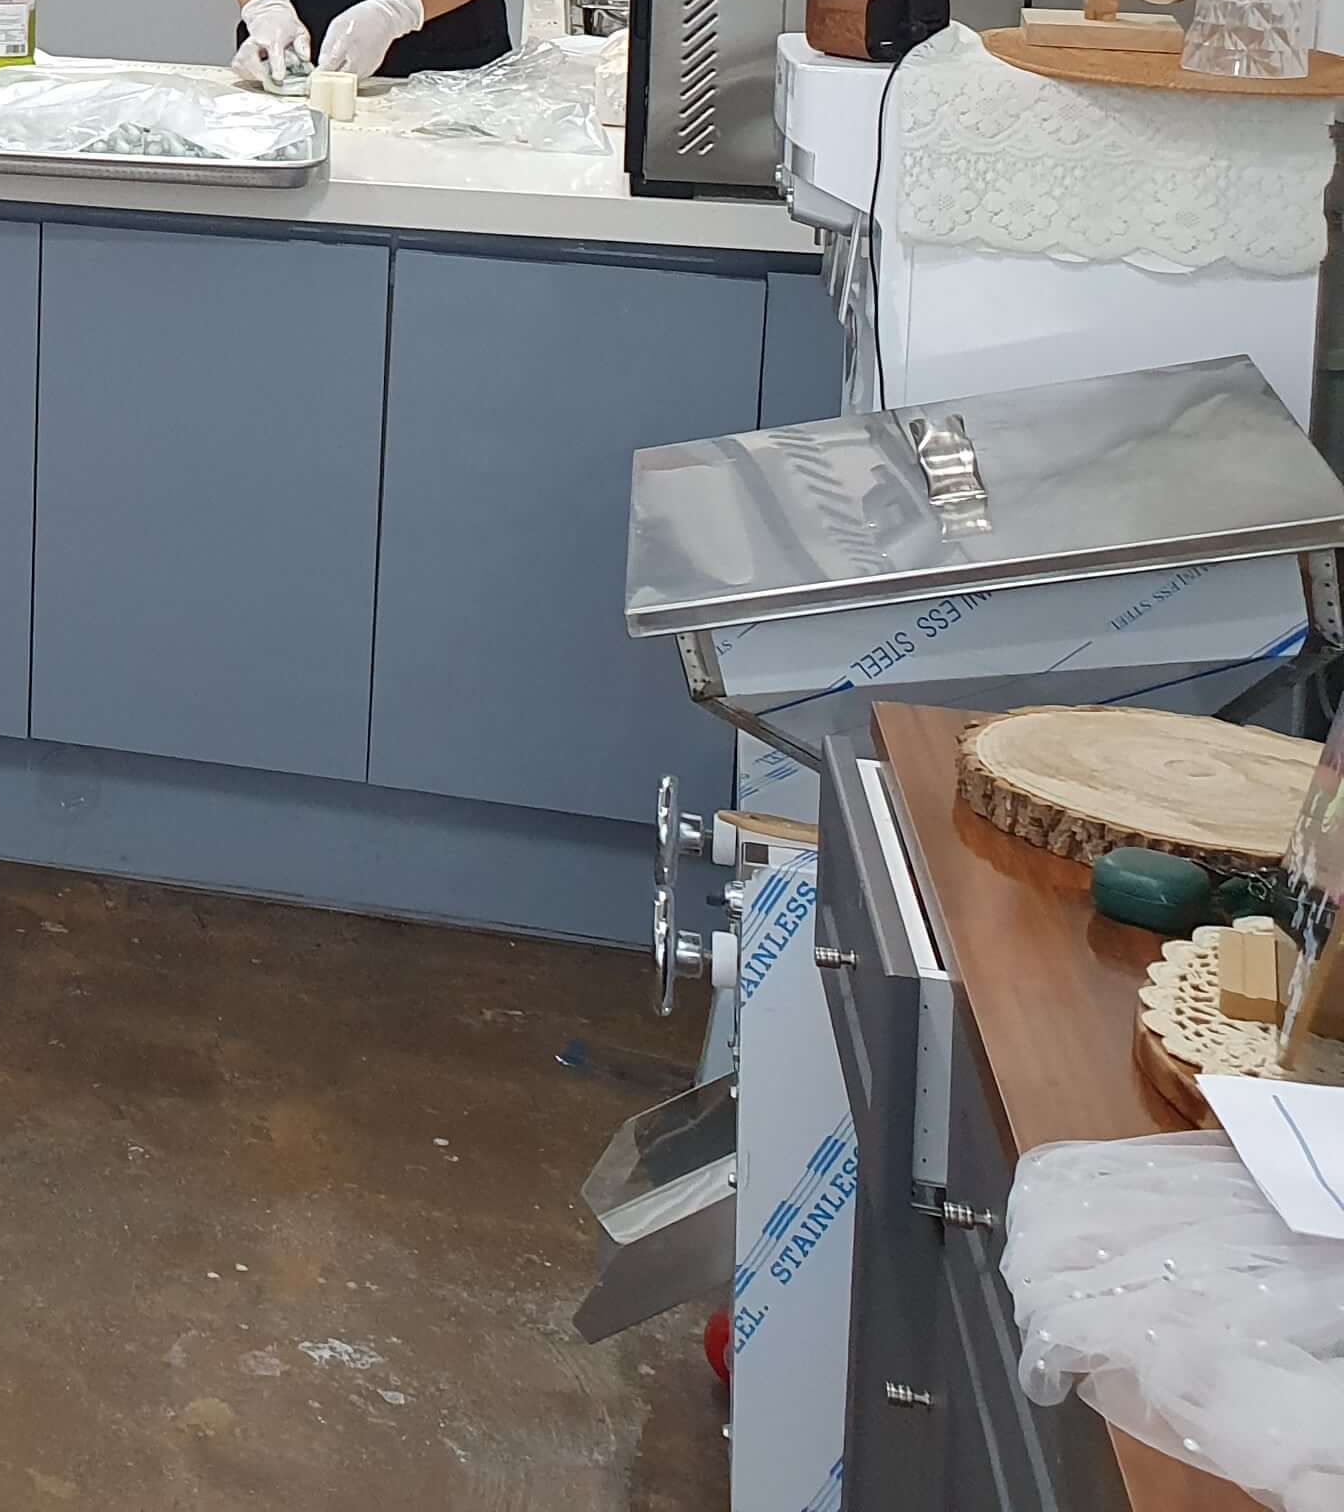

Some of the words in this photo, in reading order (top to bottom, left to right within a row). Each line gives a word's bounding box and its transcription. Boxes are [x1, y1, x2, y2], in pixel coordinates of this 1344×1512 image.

[850, 631, 915, 680] STEEL
[740, 881, 817, 1008] AINLESS
[770, 1147, 858, 1286] STAINLES
